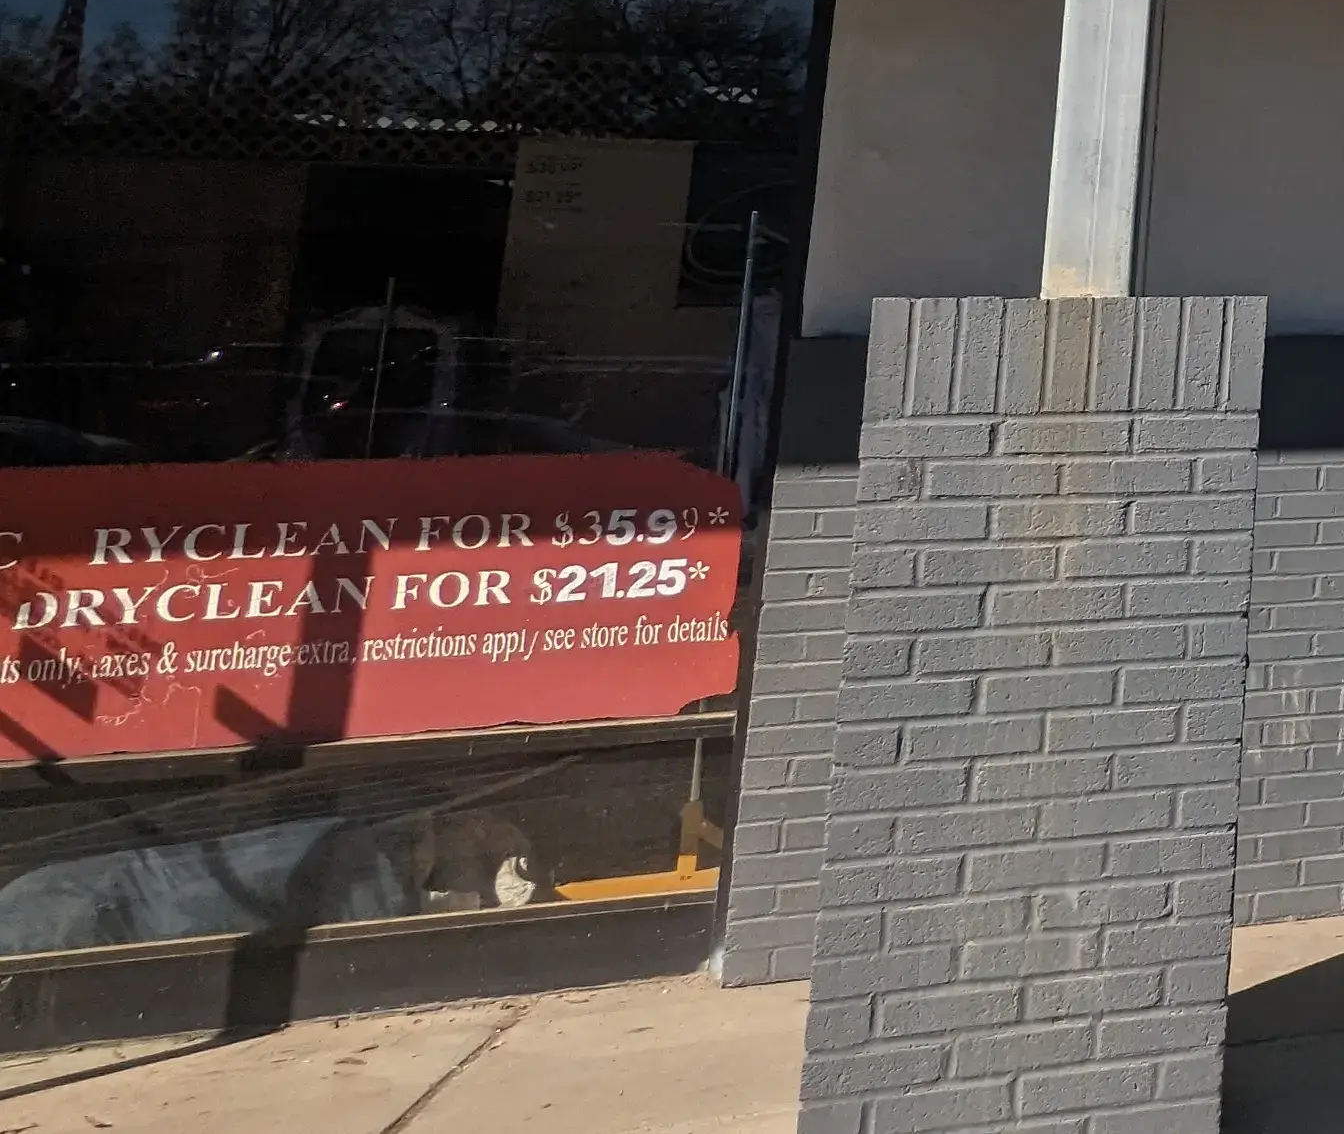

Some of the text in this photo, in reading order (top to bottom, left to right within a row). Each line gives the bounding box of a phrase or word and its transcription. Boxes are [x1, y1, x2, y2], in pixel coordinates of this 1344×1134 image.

[414, 512, 534, 552] FOR
[11, 574, 375, 632] DRYCLEAN
[391, 569, 513, 611] FOR
[156, 641, 179, 674] &
[185, 640, 293, 678] surcharge
[297, 639, 357, 667] extra,
[362, 626, 476, 662] restrictions
[543, 628, 575, 651] see
[580, 622, 629, 649] store
[635, 615, 664, 646] for
[667, 611, 728, 644] details
